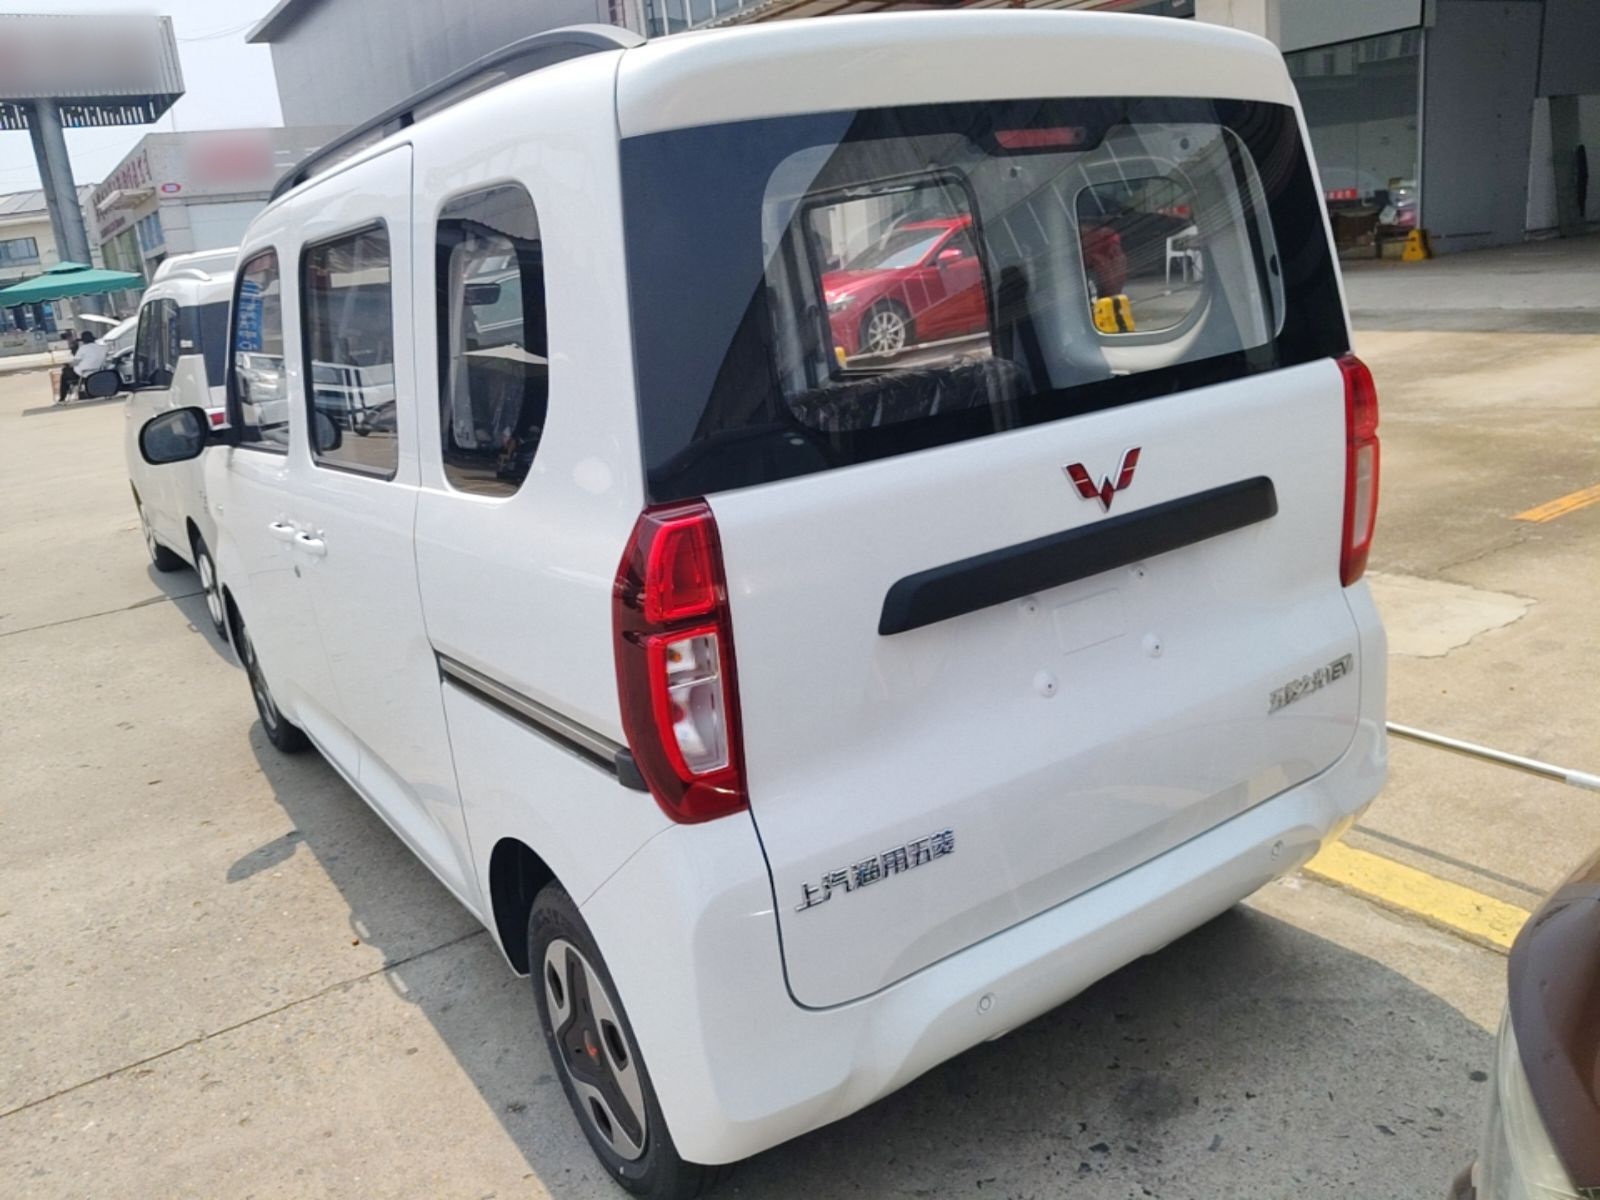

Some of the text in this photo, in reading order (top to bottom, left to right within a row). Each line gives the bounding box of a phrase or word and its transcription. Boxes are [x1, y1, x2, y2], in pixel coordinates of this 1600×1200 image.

[795, 827, 956, 912] 上汽通用五菱
